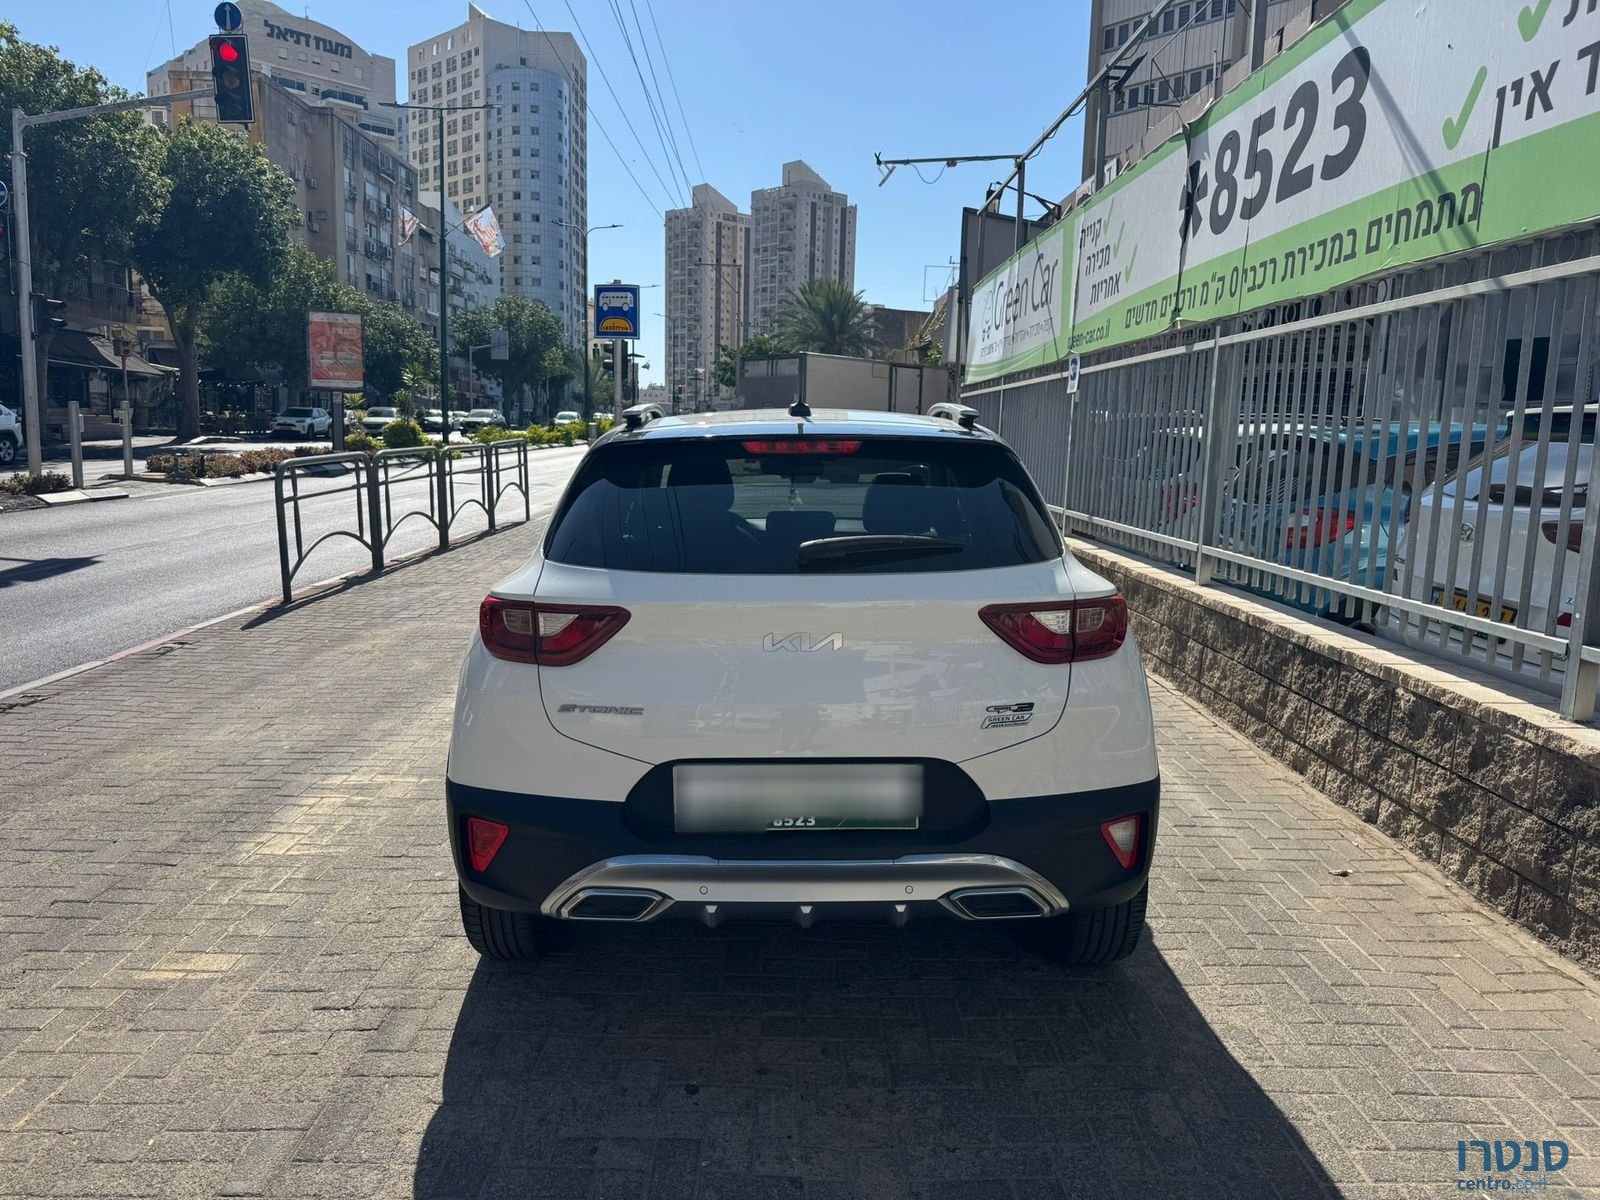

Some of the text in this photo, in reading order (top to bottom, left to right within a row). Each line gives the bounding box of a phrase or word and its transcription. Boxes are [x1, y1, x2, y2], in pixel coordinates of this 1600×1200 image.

[263, 19, 312, 48] דניאל
[1492, 59, 1561, 150] אין
[1080, 218, 1102, 248] קניית
[1365, 182, 1481, 255] מתמחים
[1085, 244, 1111, 276] מכירה
[1281, 228, 1357, 282] במכירת
[994, 253, 1058, 331] Green Car
[1089, 271, 1121, 305] אחריות
[1229, 266, 1239, 298] 0
[1125, 299, 1158, 329] חדשים
[763, 632, 843, 652] KIA
[557, 703, 644, 715] STONIC
